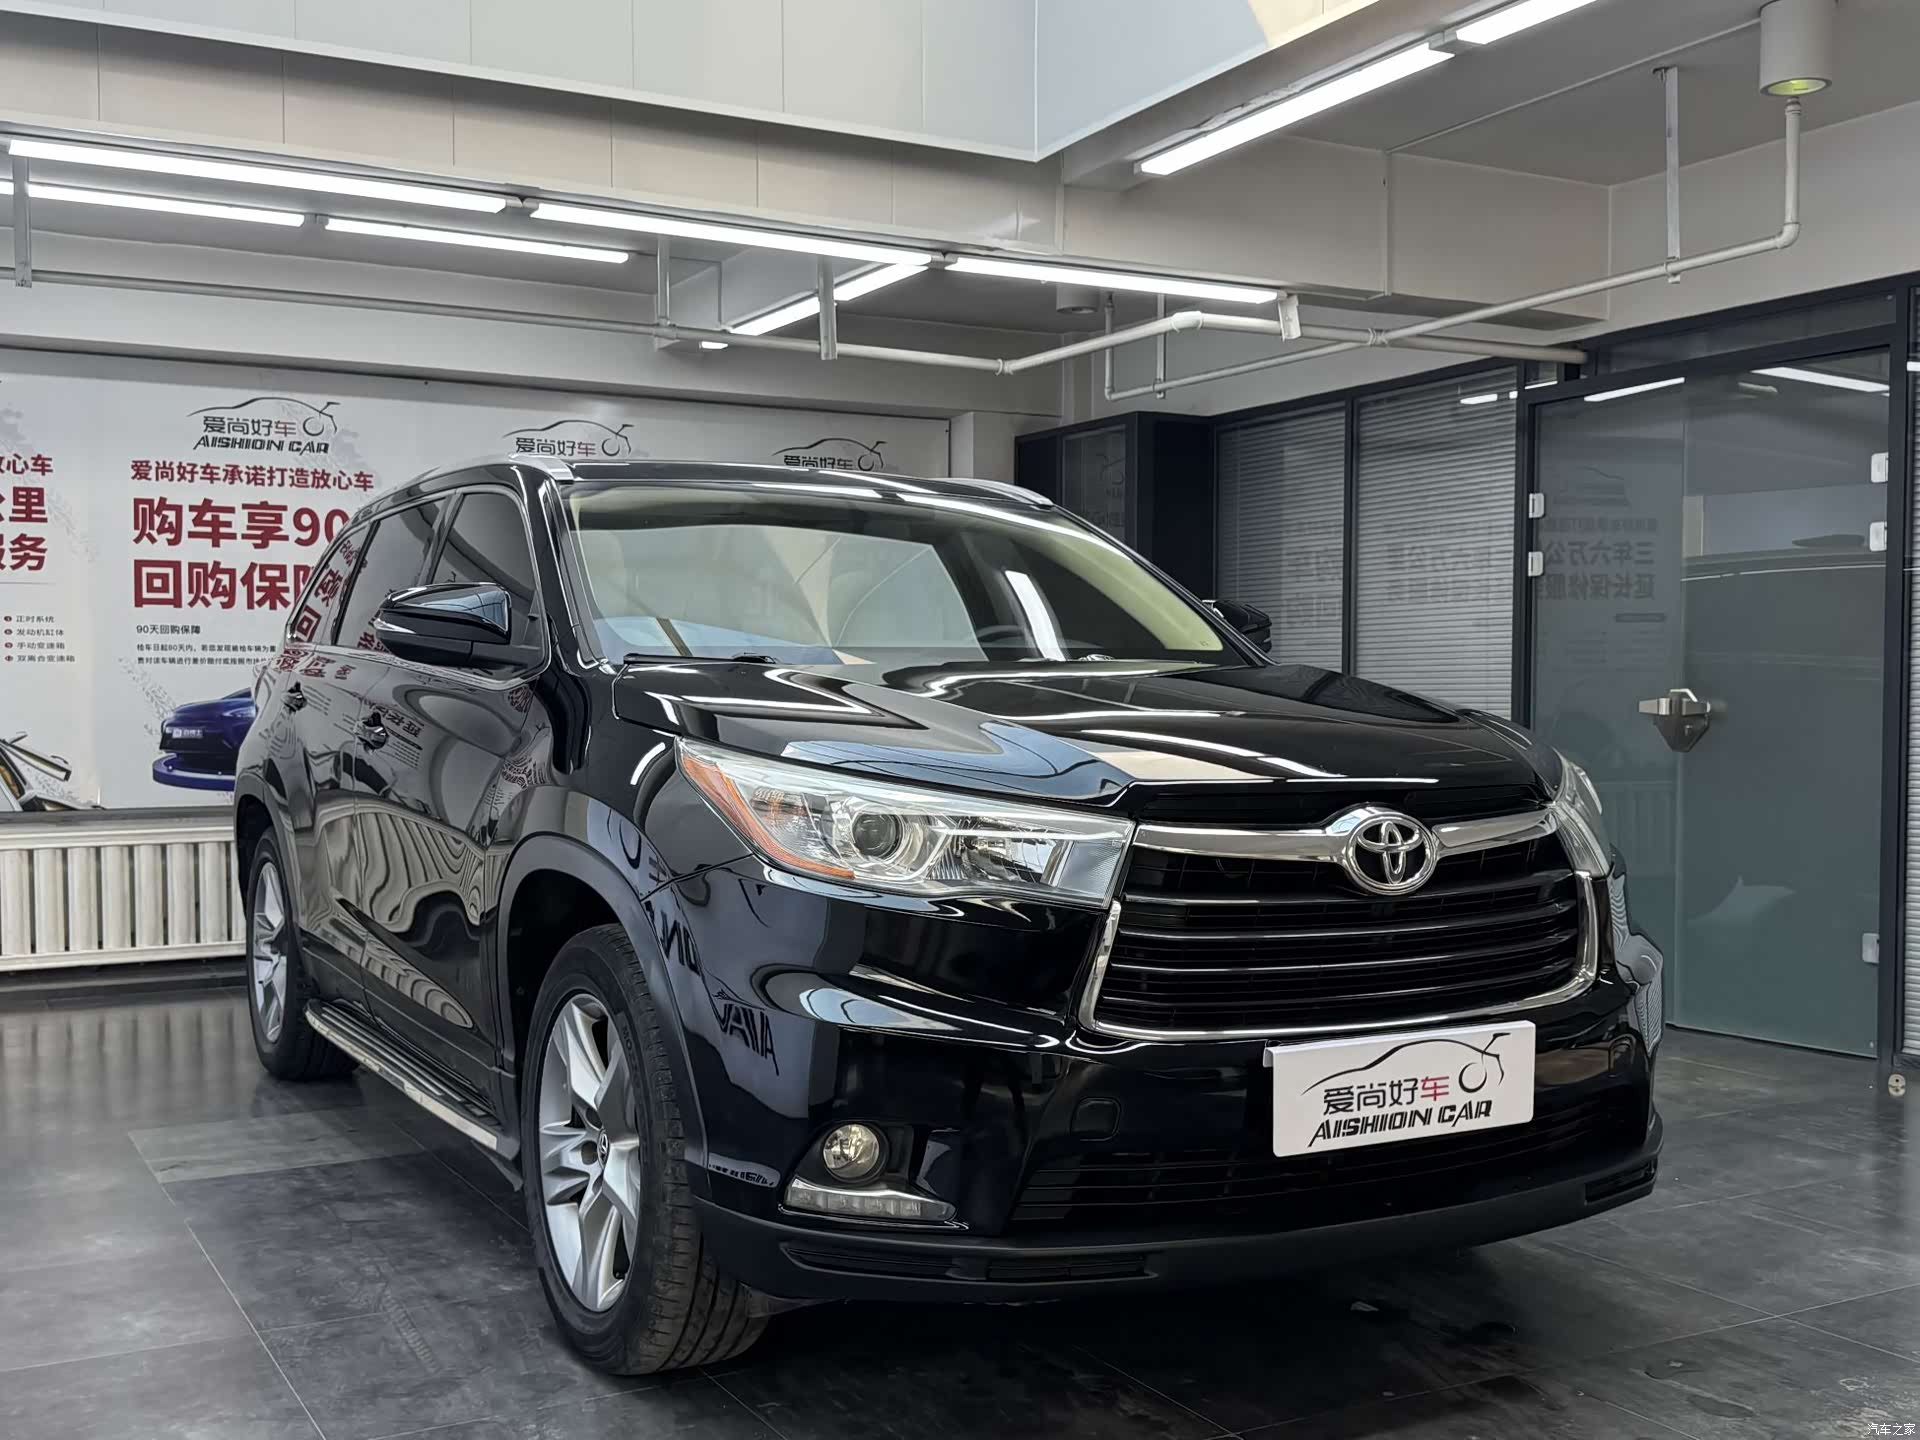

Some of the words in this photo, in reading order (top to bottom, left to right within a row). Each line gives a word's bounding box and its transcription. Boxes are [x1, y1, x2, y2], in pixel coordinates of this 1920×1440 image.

[203, 416, 297, 437] 爱尚好车
[193, 435, 284, 452] AISHION
[288, 441, 329, 456] CAR
[516, 437, 597, 457] 爱尚好车
[131, 460, 374, 492] 爱尚好车承诺打造放心车
[0, 486, 48, 523] 里
[132, 496, 350, 550] 购车享90
[133, 559, 314, 610] 回购保
[136, 624, 201, 635] 90天回购保障
[1323, 1076, 1450, 1116] 爱尚好车
[1307, 1106, 1434, 1148] AISHION
[1438, 1099, 1493, 1128] CAR
